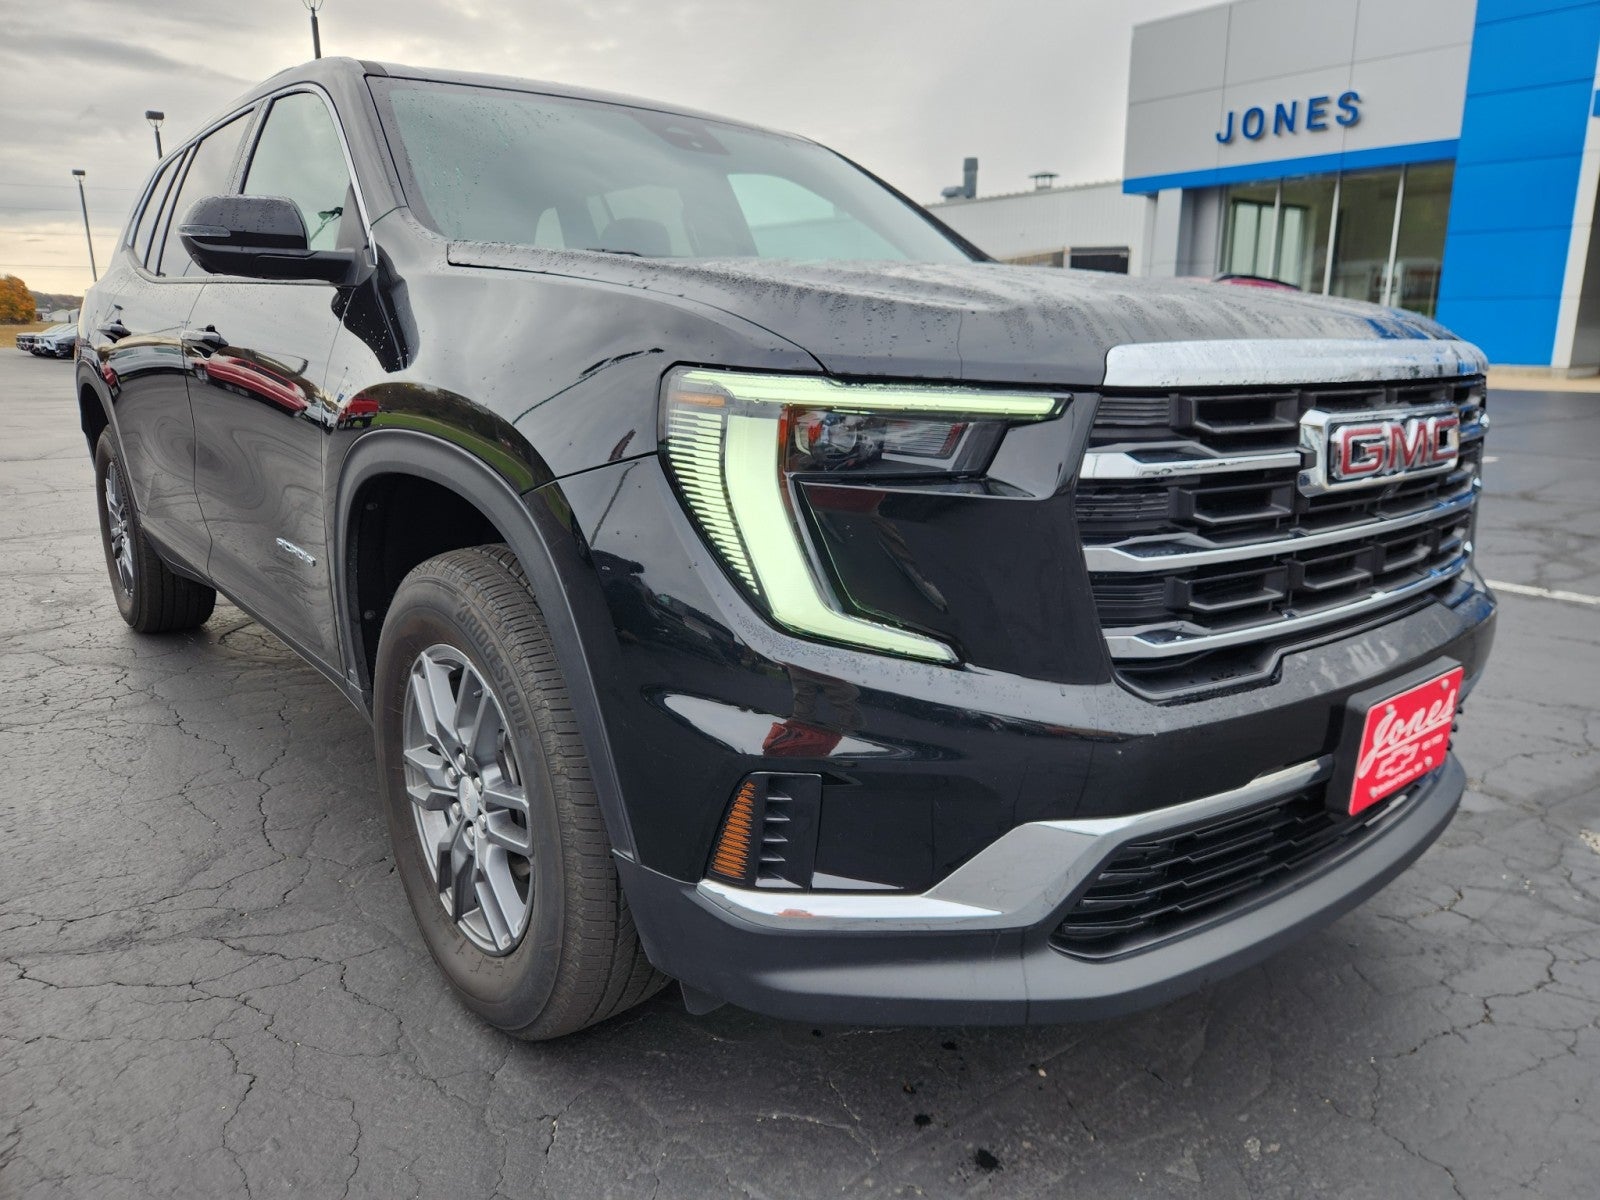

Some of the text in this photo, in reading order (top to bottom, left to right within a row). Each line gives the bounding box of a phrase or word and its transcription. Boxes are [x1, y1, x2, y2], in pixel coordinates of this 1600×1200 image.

[1216, 91, 1361, 144] JONES
[1335, 416, 1459, 479] GMC
[455, 601, 531, 738] BRIDGESTONE
[1357, 688, 1457, 779] Jones
